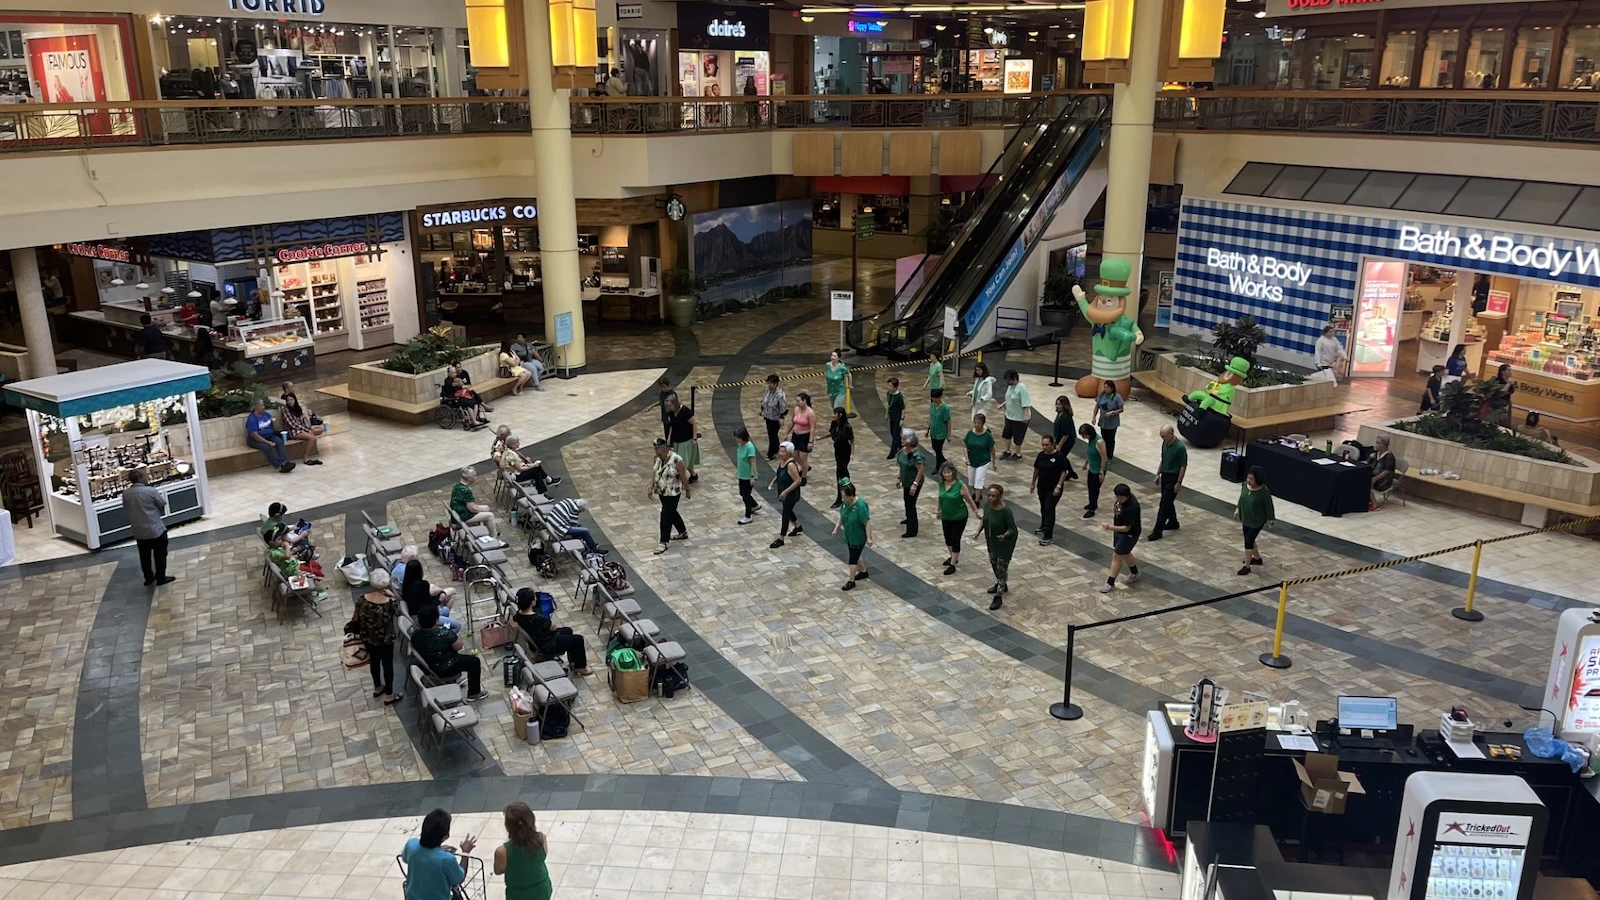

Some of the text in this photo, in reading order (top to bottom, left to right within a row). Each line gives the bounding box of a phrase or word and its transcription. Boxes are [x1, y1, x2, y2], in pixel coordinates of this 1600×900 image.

[231, 0, 325, 14] TORRID
[707, 19, 746, 38] claire's
[48, 52, 87, 70] FAMOUS
[423, 206, 507, 227] STARBUCKS
[67, 243, 130, 262] Cookie Corner
[279, 242, 366, 261] Cookie Corner
[1399, 225, 1461, 257] Bath
[1464, 233, 1487, 261] &
[1489, 235, 1572, 277] Body
[985, 247, 1019, 297] You Can Join!
[1207, 248, 1312, 287] Bath & Body
[1229, 273, 1284, 302] Works
[1520, 382, 1544, 396] Body
[1545, 388, 1575, 402] Works
[1466, 823, 1511, 833] TrickedOut
